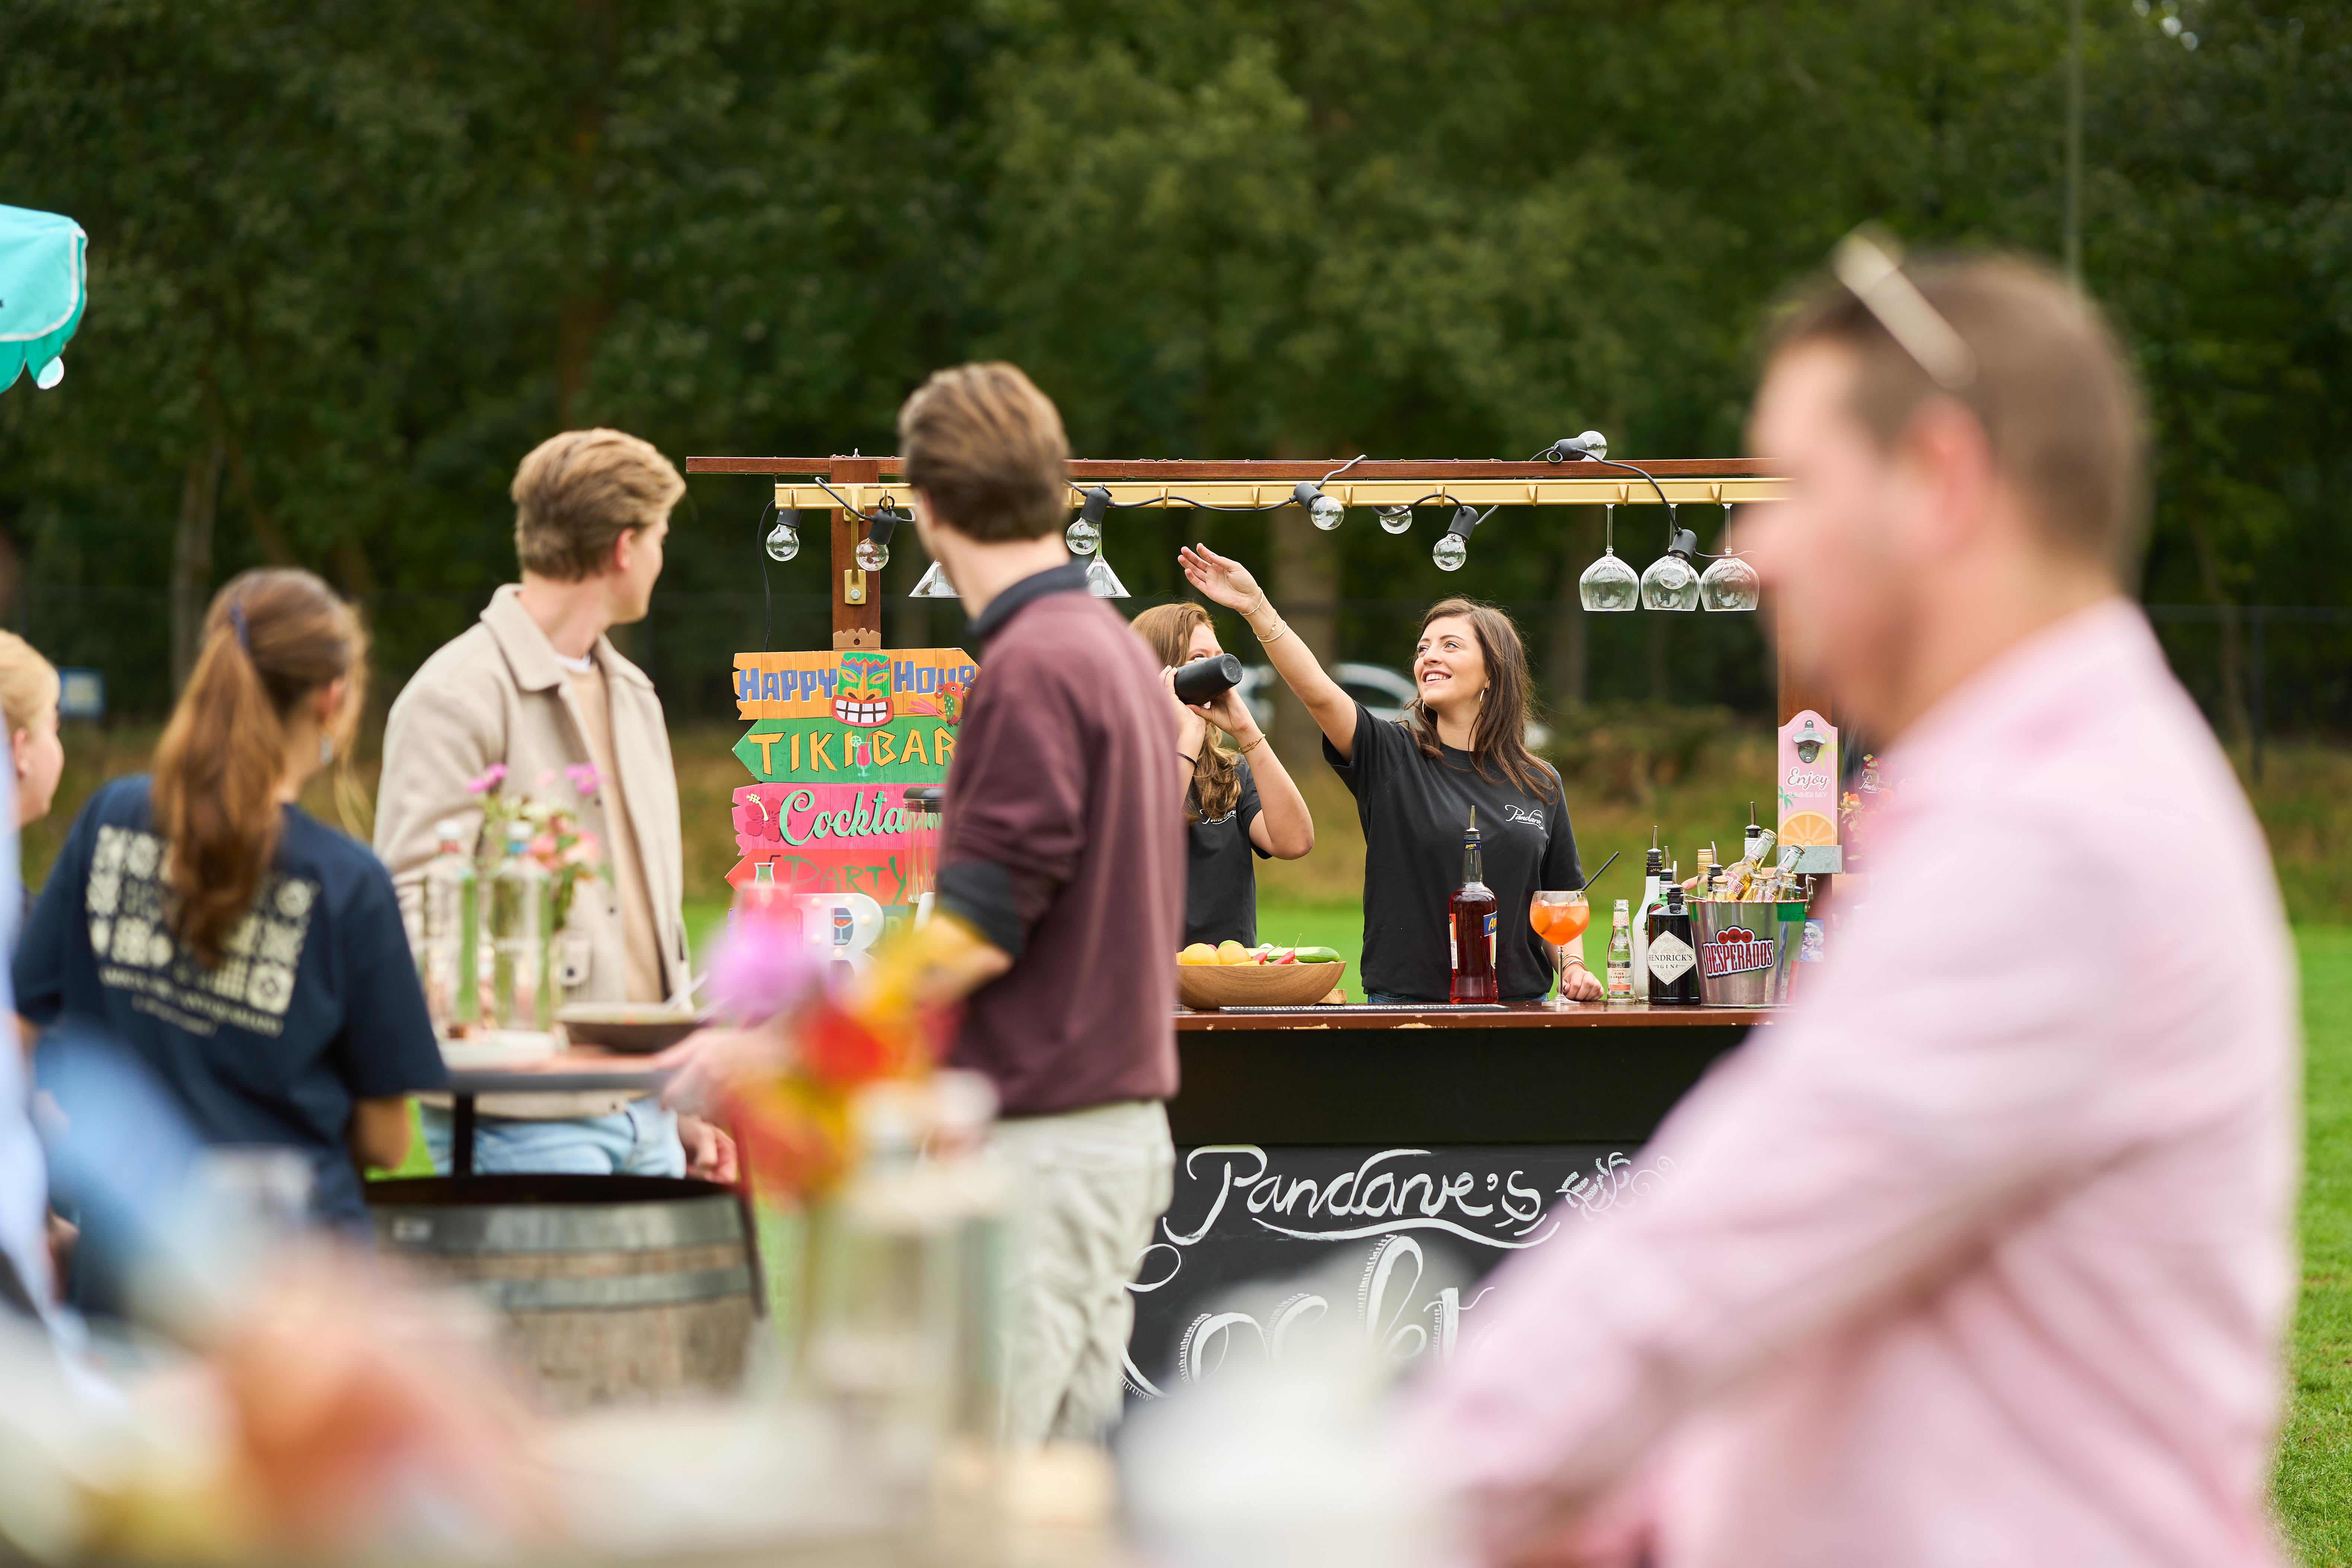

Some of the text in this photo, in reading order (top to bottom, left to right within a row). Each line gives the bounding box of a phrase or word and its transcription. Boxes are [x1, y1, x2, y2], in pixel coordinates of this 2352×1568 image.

[739, 661, 976, 702] HAPPY HOUR
[747, 726, 958, 775] TIKI BAR
[1787, 768, 1830, 789] Enjoy
[779, 789, 908, 846] Cockta
[783, 855, 906, 906] PARTY
[1704, 942, 1773, 974] DESPERADOS
